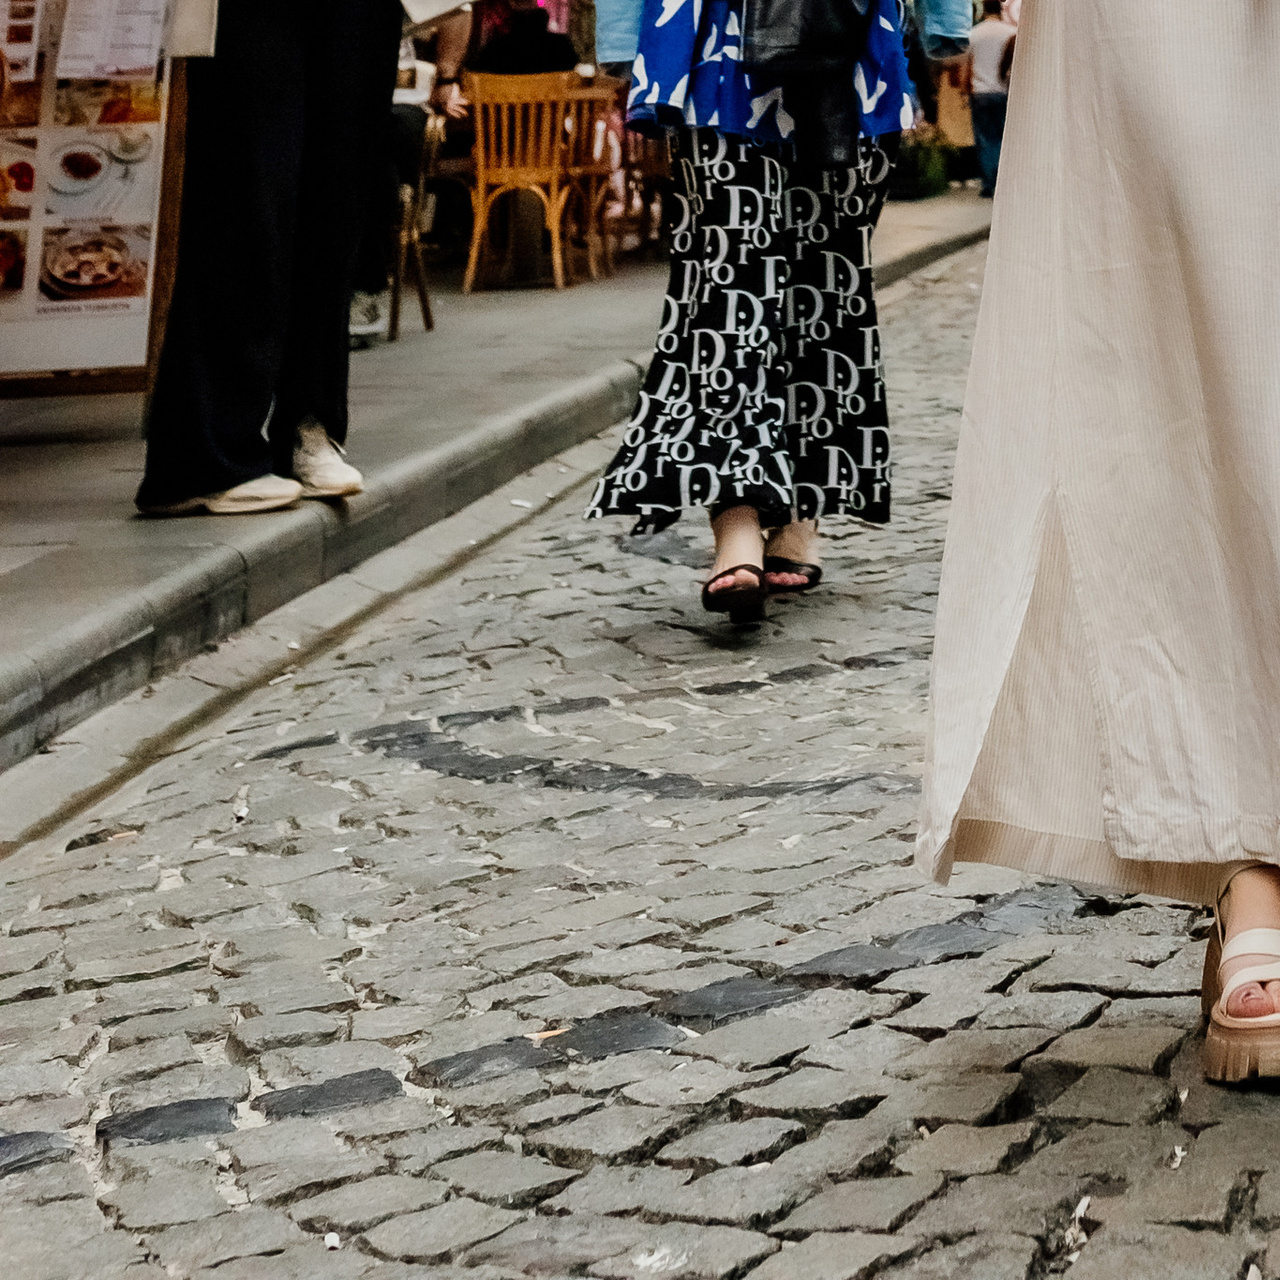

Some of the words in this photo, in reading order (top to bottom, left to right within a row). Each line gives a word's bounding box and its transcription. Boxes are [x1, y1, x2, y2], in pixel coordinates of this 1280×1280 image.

[722, 185, 772, 265] Dior
[784, 186, 829, 260] Dior
[700, 225, 735, 304] Dior
[821, 250, 867, 328] Dior
[719, 289, 770, 368] Dior
[786, 284, 831, 357] Dior
[648, 359, 694, 433] Dior
[689, 328, 734, 410] Dior
[820, 348, 866, 426] Dior
[784, 381, 833, 456] Dior
[823, 445, 867, 514] Dior
